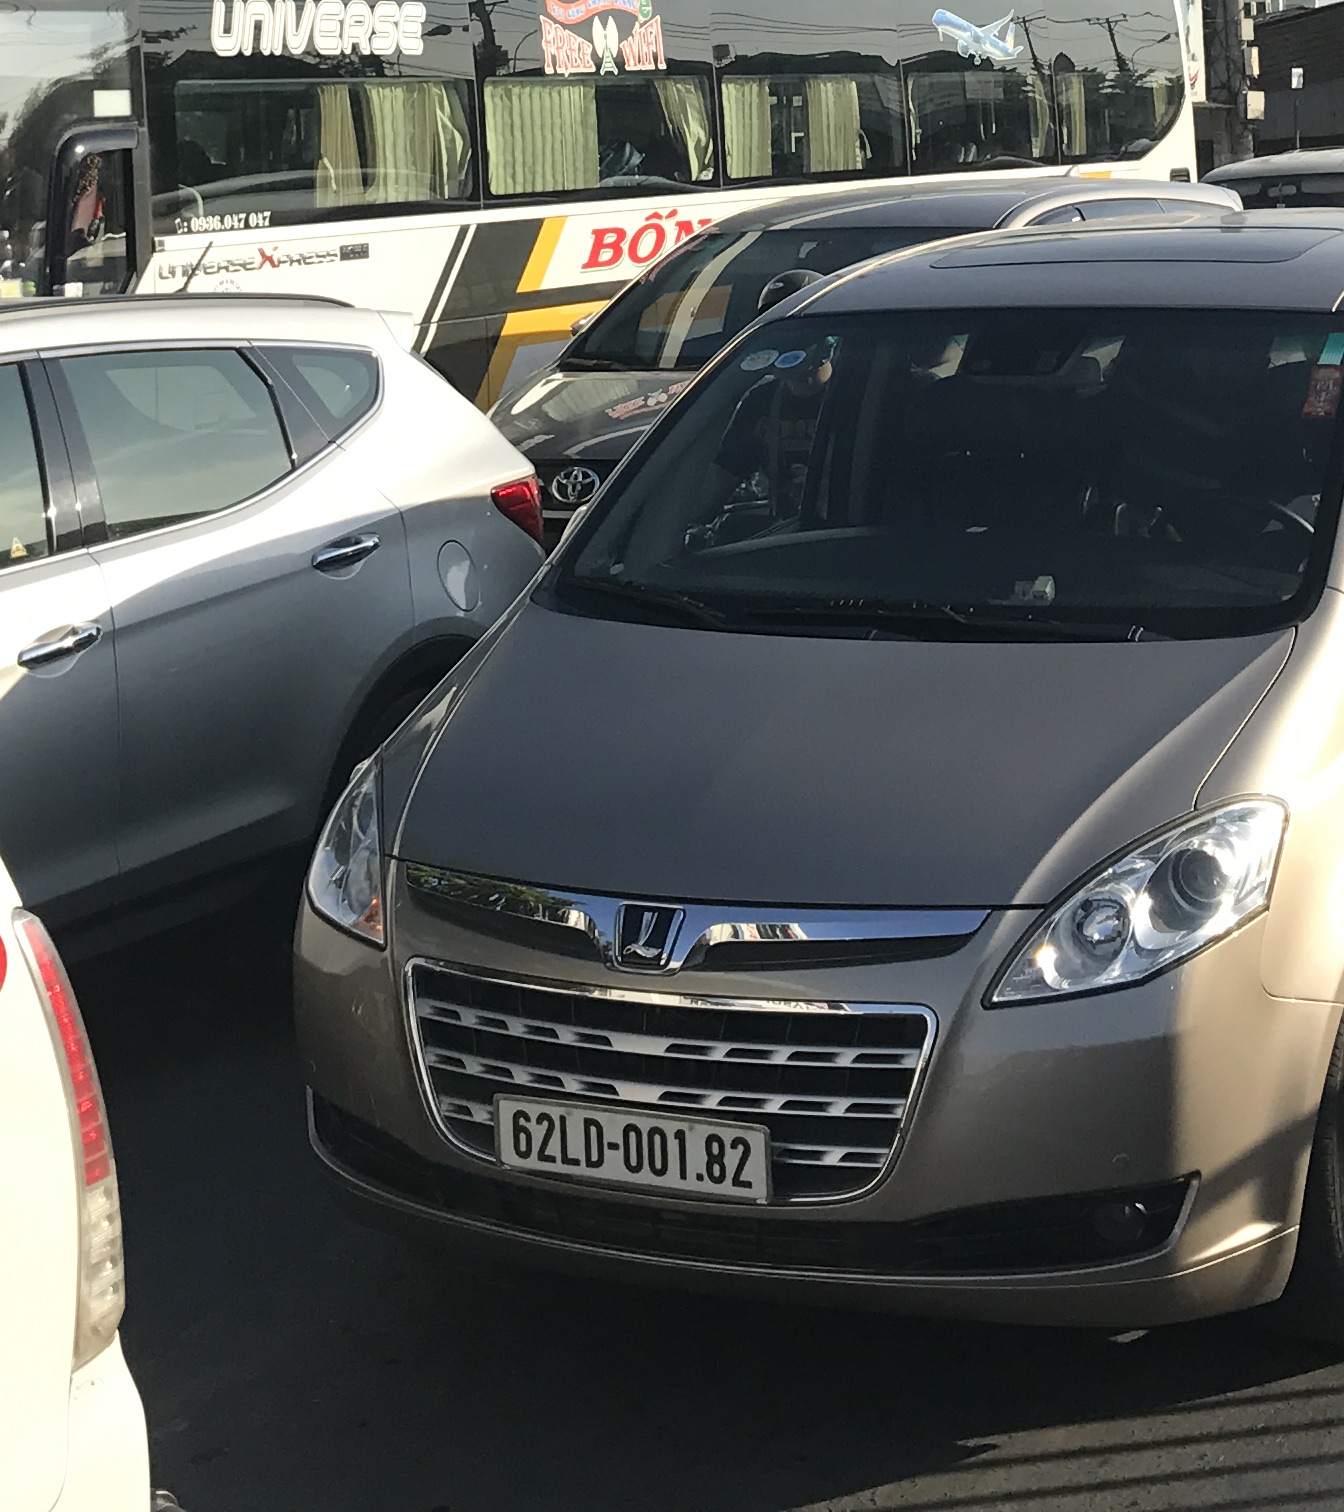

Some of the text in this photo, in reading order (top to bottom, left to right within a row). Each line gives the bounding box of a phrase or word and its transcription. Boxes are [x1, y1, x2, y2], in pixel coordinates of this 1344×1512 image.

[540, 15, 667, 77] FREE WIFI
[248, 211, 272, 228] 047
[511, 1109, 753, 1189] 62LD-001.82
